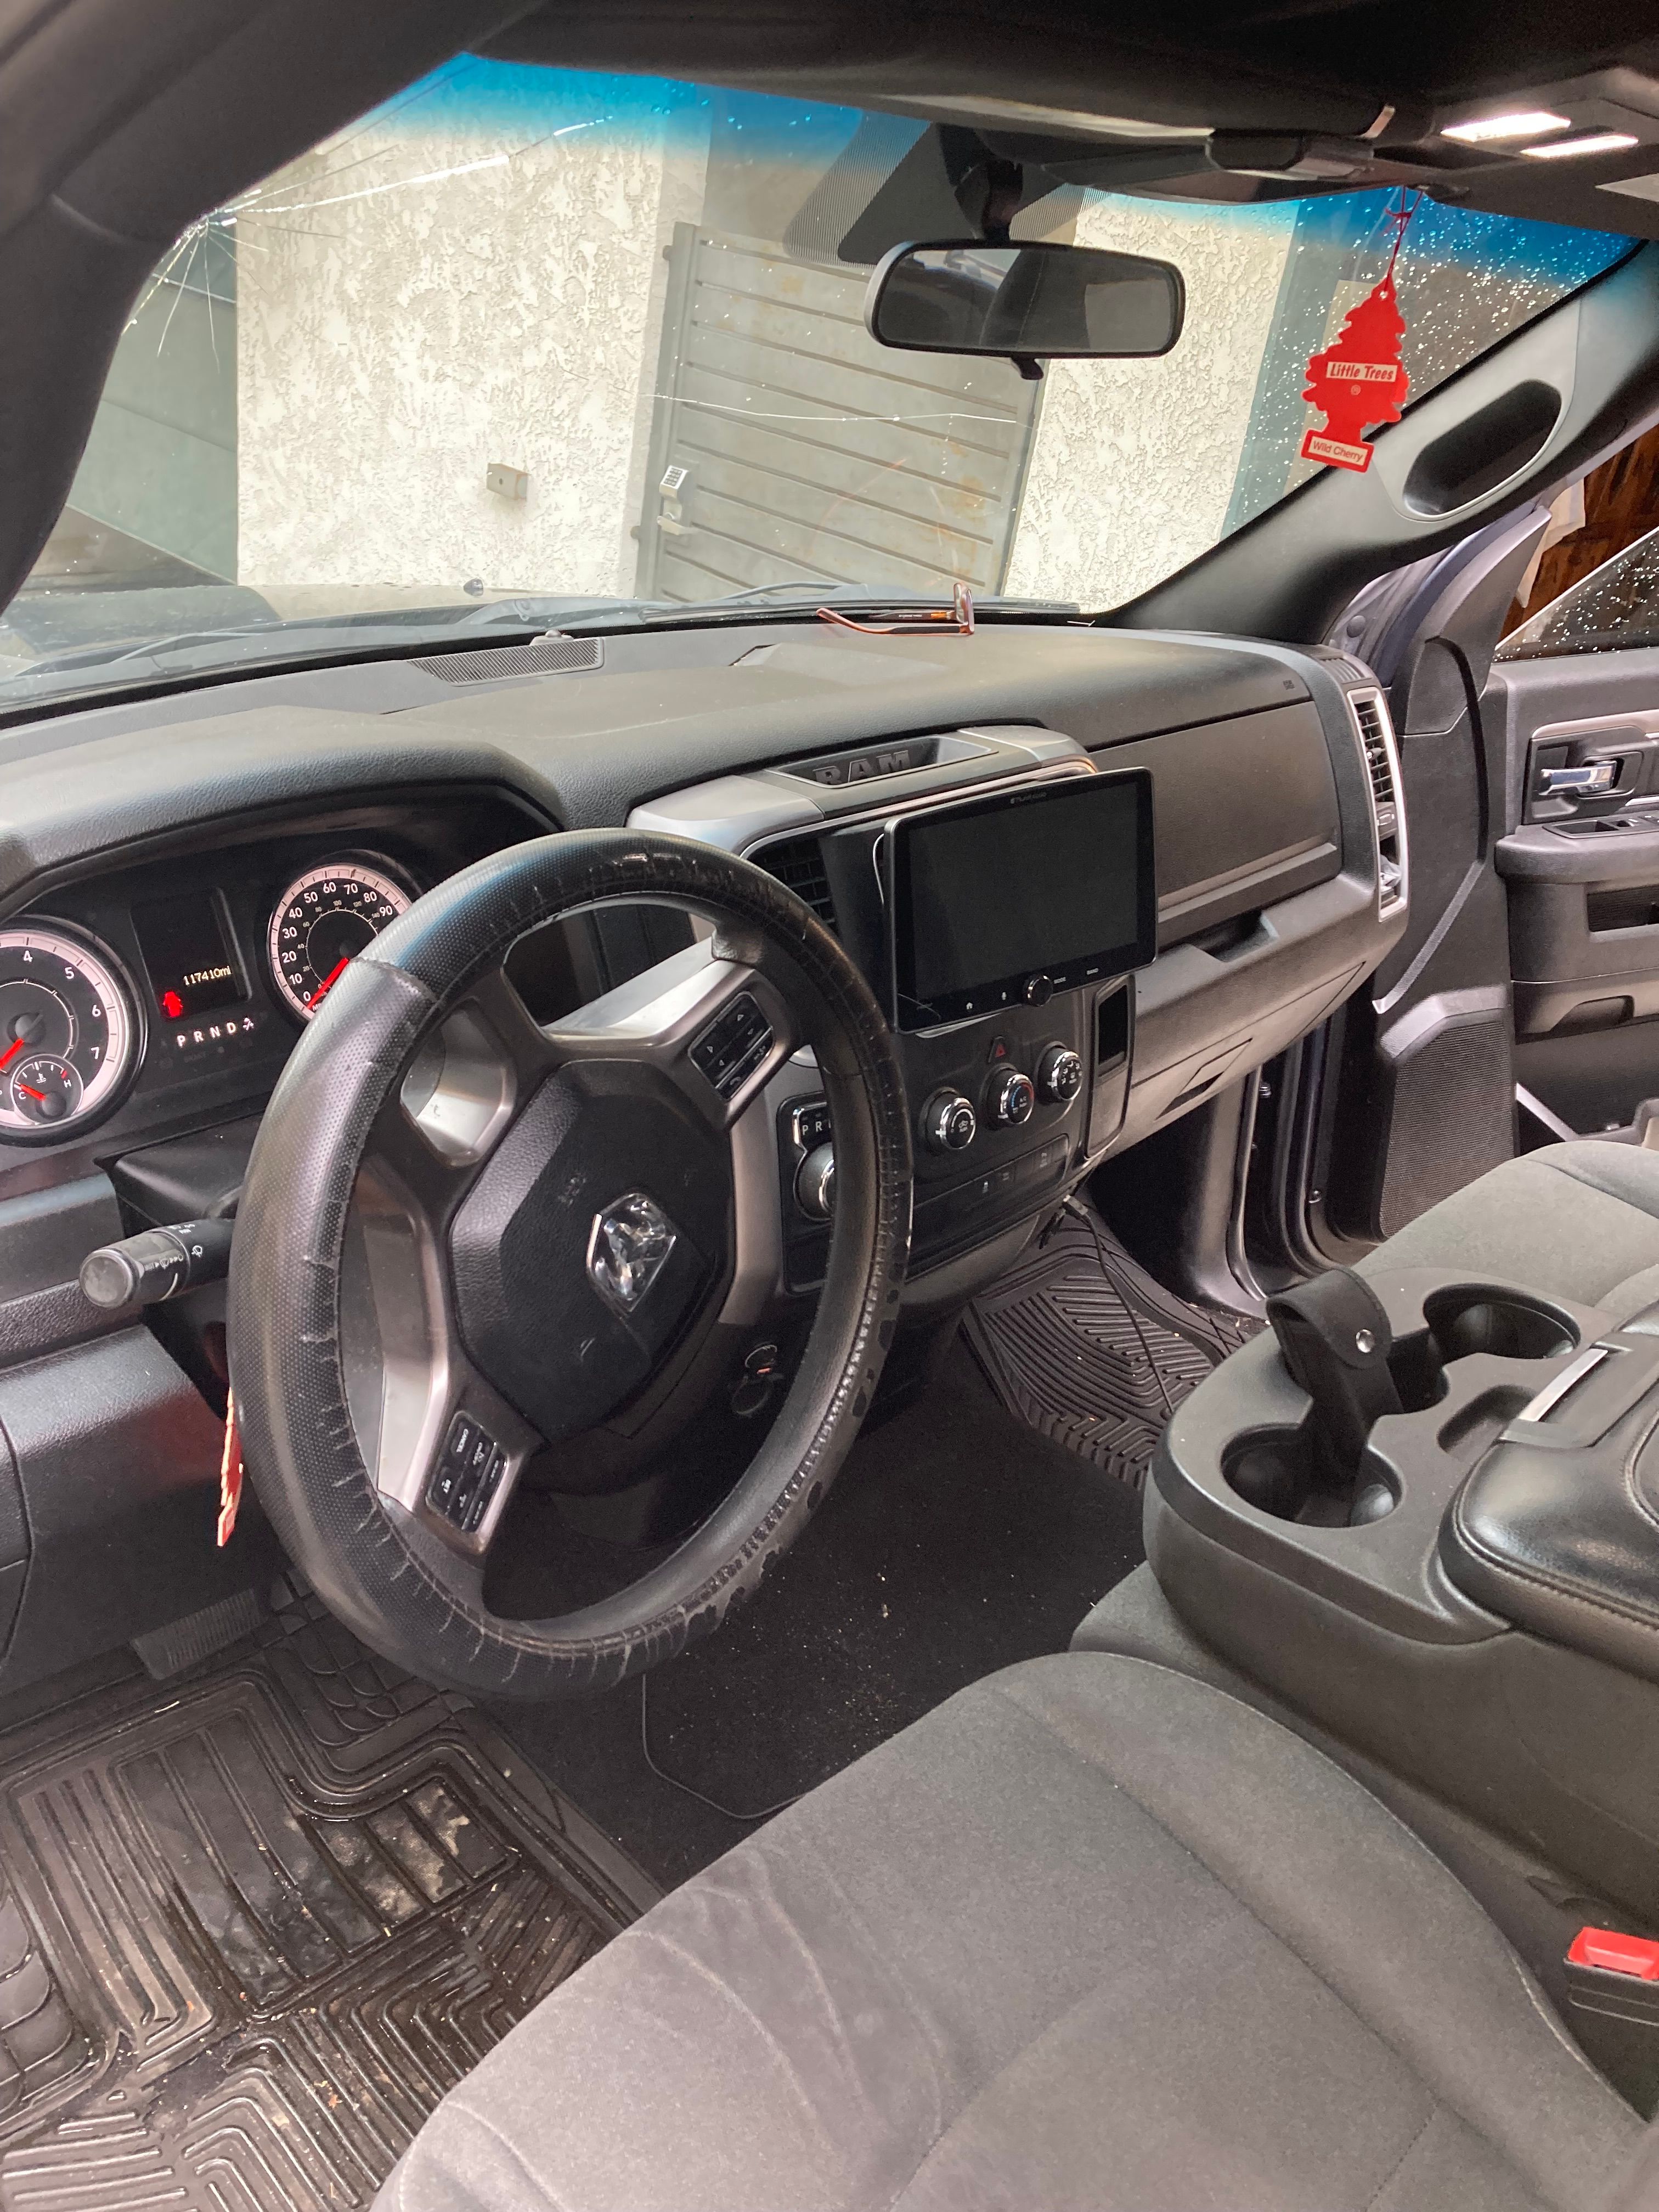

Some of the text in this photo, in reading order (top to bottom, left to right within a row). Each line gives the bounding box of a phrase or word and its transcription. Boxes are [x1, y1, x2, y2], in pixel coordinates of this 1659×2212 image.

[1330, 363, 1394, 380] Little Trees
[1313, 440, 1363, 462] Wild Cherry
[812, 749, 911, 785] RAM
[323, 882, 336, 894] 60
[343, 883, 358, 895] 70
[303, 891, 318, 904] 50
[363, 890, 377, 902] 80
[289, 907, 302, 918] 40
[379, 905, 393, 917] 90
[282, 926, 297, 939] 30
[23, 950, 33, 963] 4
[281, 950, 297, 963] 20
[65, 967, 75, 979] 5
[183, 966, 232, 985] 117410mi
[289, 973, 302, 985] 10
[303, 990, 311, 1002] 0
[92, 1005, 101, 1017] 6
[177, 1022, 236, 1047] P R N D
[91, 1046, 100, 1059] 7
[64, 1079, 71, 1088] H
[18, 1091, 26, 1100] C
[802, 1125, 809, 1135] P
[815, 1121, 822, 1132] R
